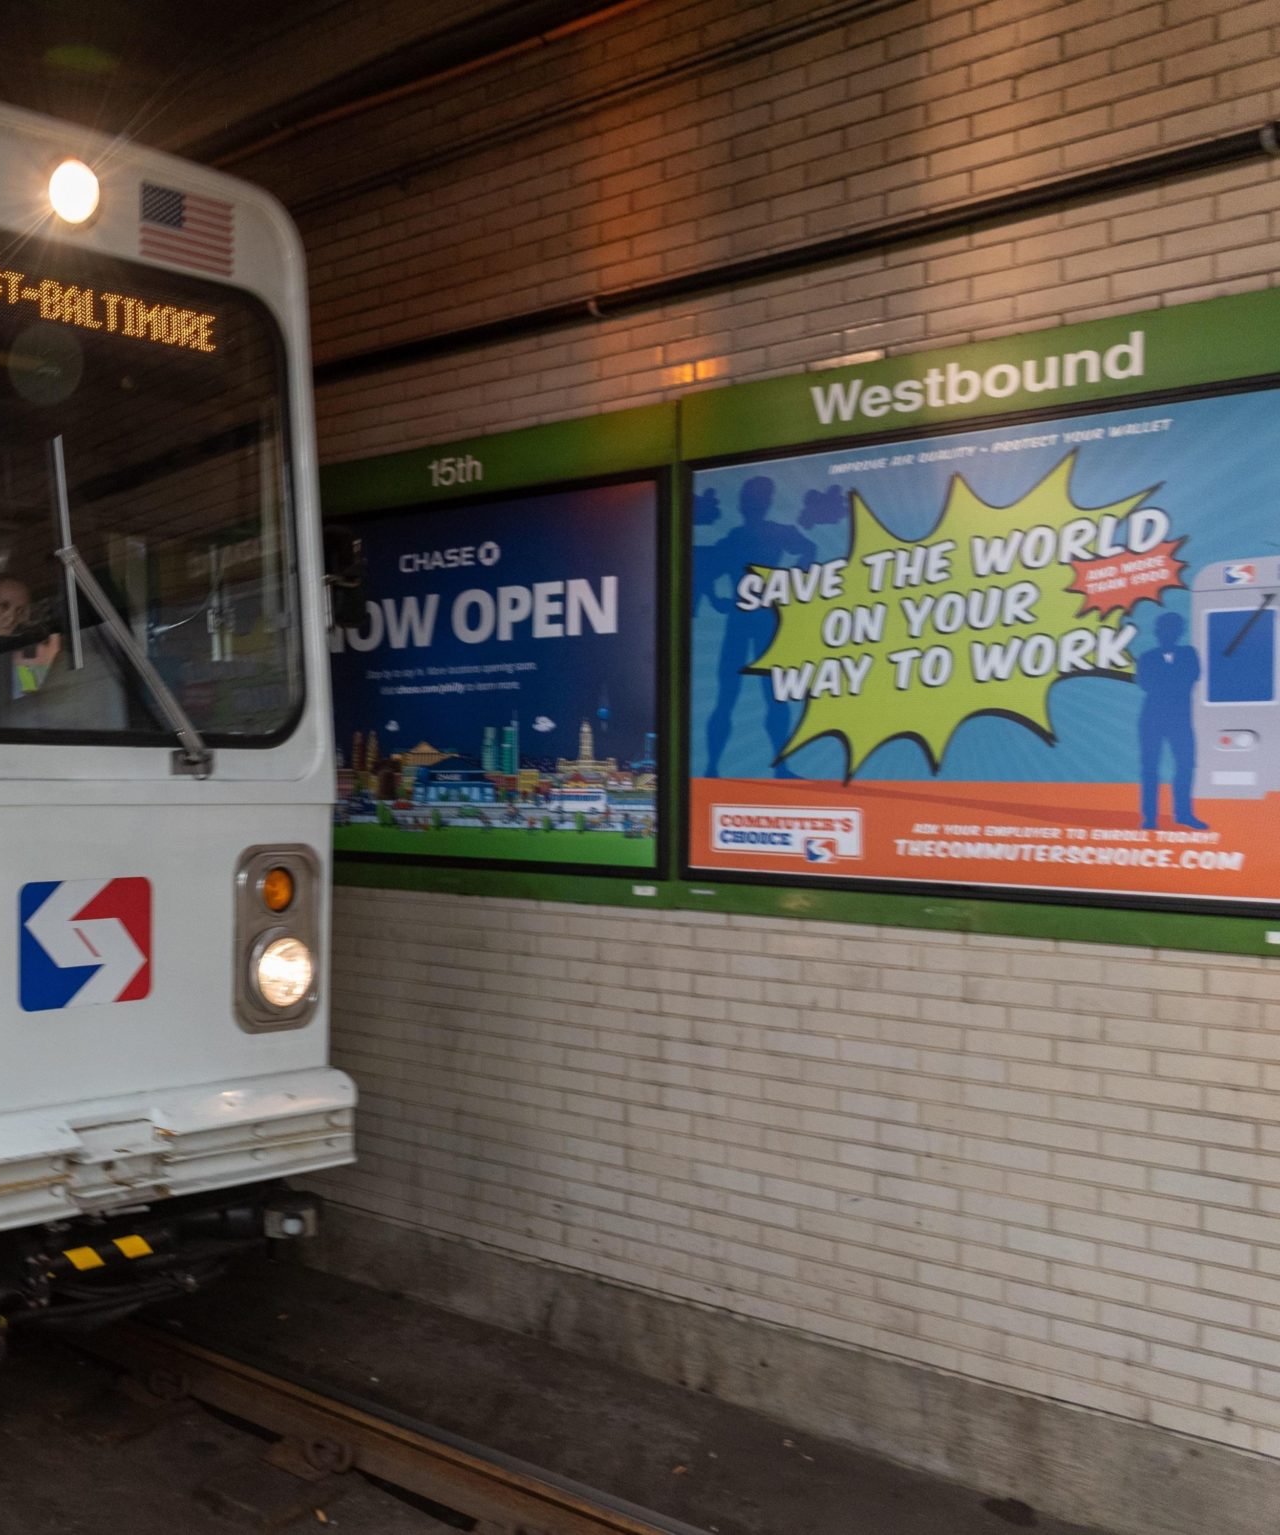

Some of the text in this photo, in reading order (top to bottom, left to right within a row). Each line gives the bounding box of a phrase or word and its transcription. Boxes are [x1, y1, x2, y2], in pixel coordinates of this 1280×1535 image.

[811, 330, 1145, 425] Westbound
[1062, 428, 1106, 443] YOUR
[428, 454, 483, 488] 15th
[398, 546, 476, 573] CHASE
[736, 507, 1170, 611] SAVE THE WORLD
[328, 575, 619, 654] OW OPEN
[823, 580, 1041, 648] ON YOUR
[771, 622, 1138, 701] WAY TO WORK
[719, 829, 792, 846] CHOICE
[720, 814, 853, 833] COMMUTER'S
[912, 823, 941, 835] ASK
[942, 824, 982, 837] YOUR
[983, 825, 1063, 840] EMPLOYER
[1065, 828, 1089, 841] TO
[1090, 828, 1150, 843] ENROLL
[893, 838, 1245, 872] THECOMMUTERSCHOICE.COM
